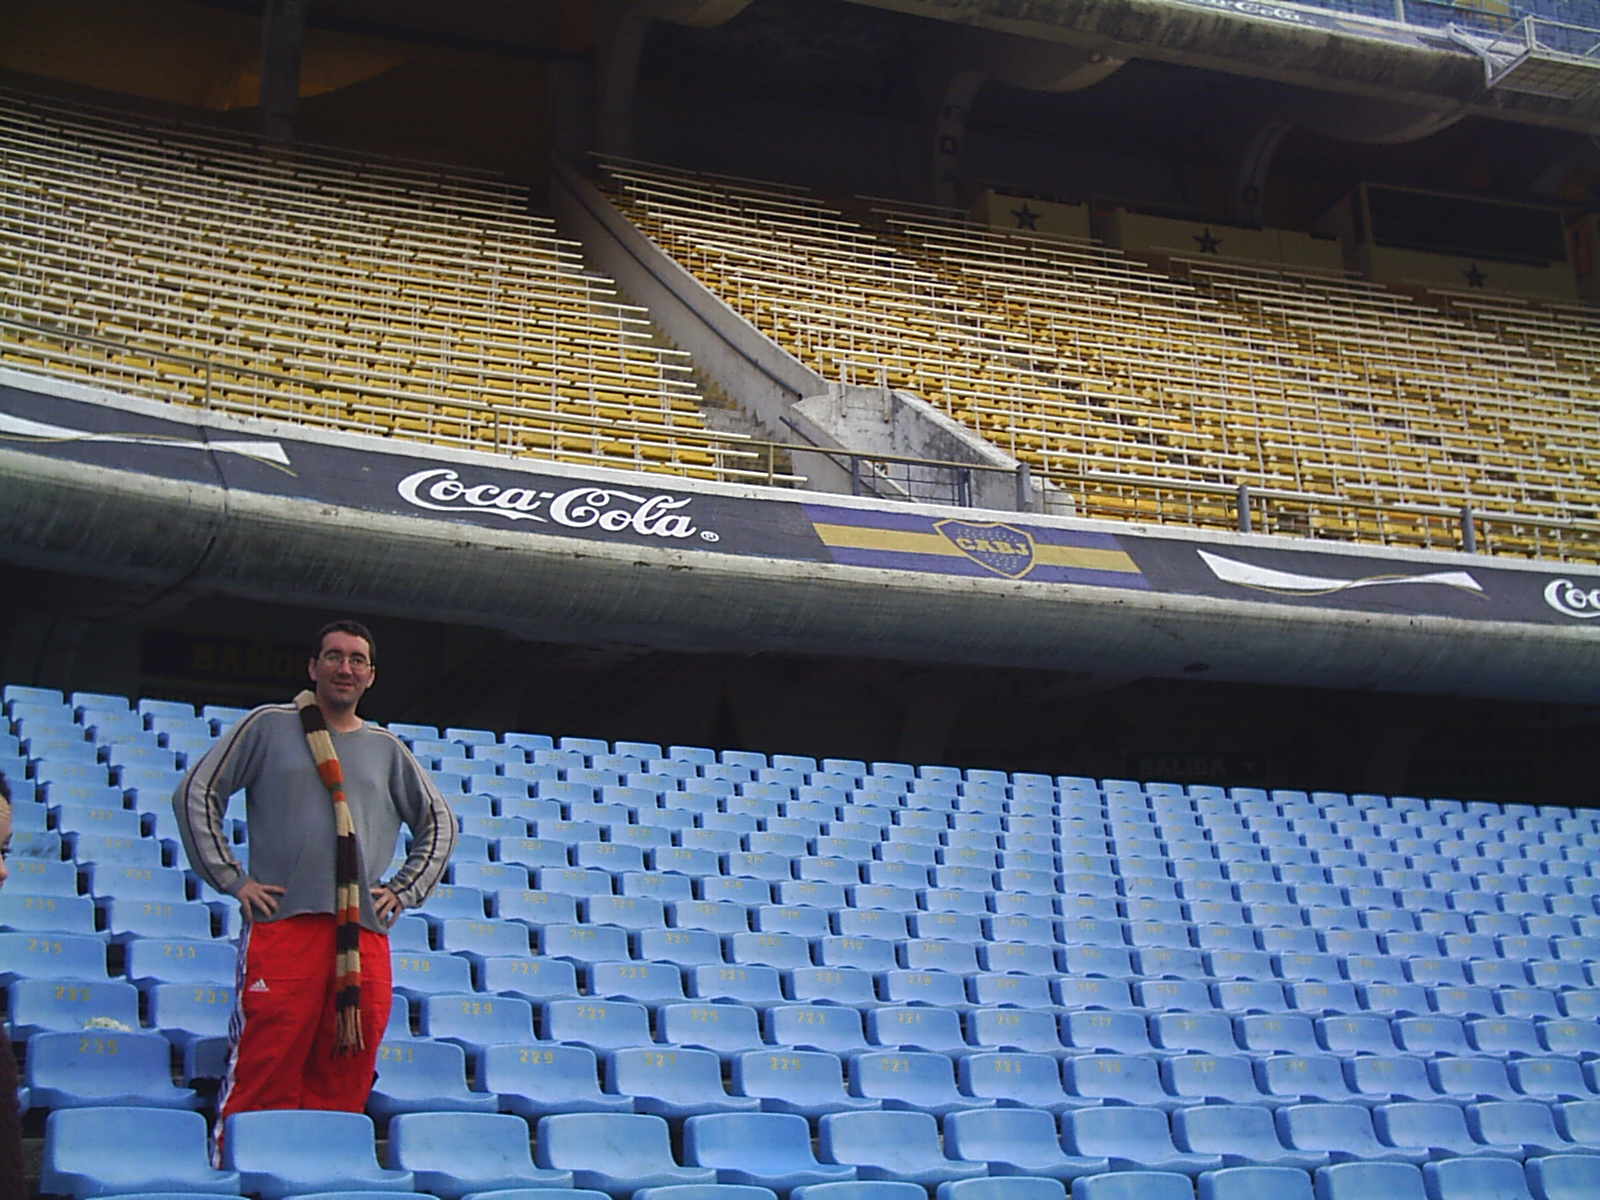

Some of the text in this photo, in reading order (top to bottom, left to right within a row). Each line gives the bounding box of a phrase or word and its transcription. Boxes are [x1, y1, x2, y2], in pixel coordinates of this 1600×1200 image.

[397, 468, 697, 538] Coca-Cola
[104, 836, 132, 850] 233
[17, 861, 46, 875] 235
[124, 867, 152, 881] 233
[24, 897, 56, 912] 235
[522, 890, 549, 904] 225
[142, 902, 172, 917] 233
[467, 922, 495, 936] 227
[569, 927, 596, 941] 225
[664, 931, 691, 945] 223
[27, 937, 63, 955] 235
[162, 944, 196, 959] 233
[400, 957, 431, 973] 229
[510, 960, 540, 975] 227
[619, 965, 648, 979] 225
[718, 967, 746, 982] 223
[53, 984, 91, 1002] 235
[193, 988, 228, 1004] 233
[460, 1000, 494, 1015] 229
[576, 1004, 607, 1021] 227
[690, 1008, 719, 1023] 225
[796, 1010, 826, 1025] 223
[77, 1037, 119, 1056] 235
[379, 1047, 414, 1063] 231
[518, 1048, 555, 1065] 229
[643, 1051, 677, 1068] 227
[768, 1055, 802, 1072] 225
[880, 1057, 910, 1073] 223
[993, 1058, 1022, 1074] 221
